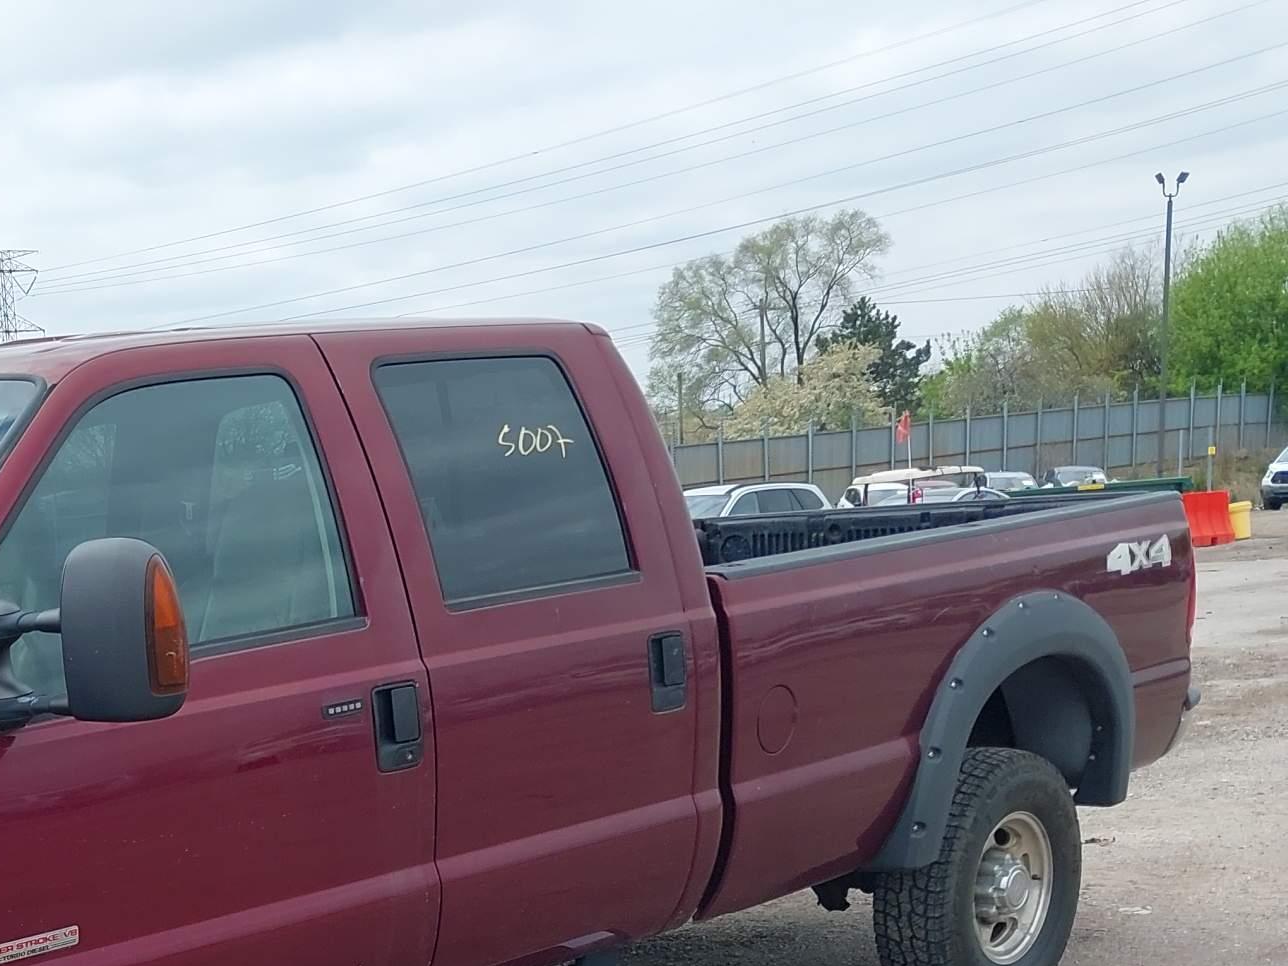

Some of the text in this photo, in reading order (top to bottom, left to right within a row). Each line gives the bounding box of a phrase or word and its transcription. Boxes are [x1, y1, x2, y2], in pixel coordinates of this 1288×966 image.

[1107, 534, 1172, 576] 4X4
[16, 934, 59, 949] STROKE
[64, 929, 77, 937] V8
[2, 944, 50, 961] TURBO DIESEL
